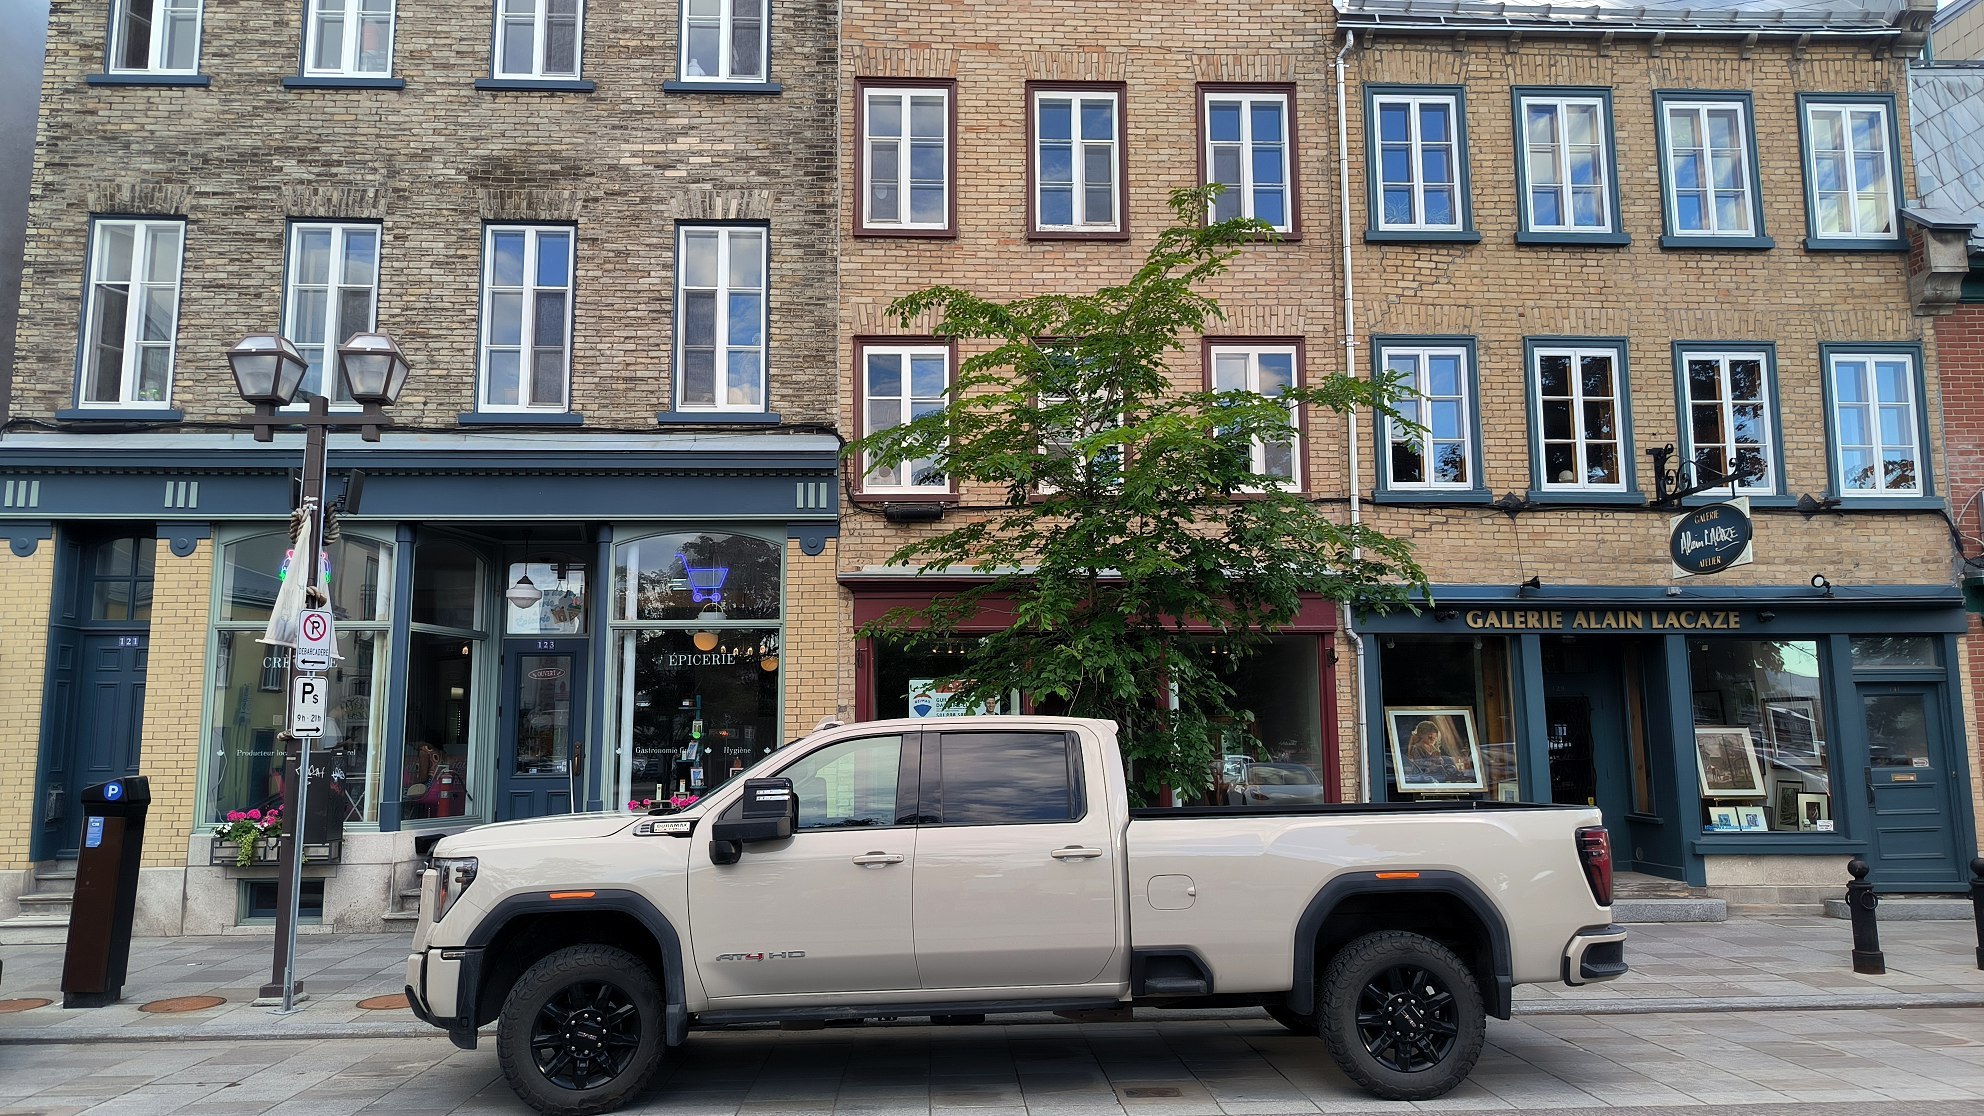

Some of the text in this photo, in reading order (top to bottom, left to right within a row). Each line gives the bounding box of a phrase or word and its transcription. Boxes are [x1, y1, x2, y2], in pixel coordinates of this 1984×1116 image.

[1695, 510, 1720, 525] GALERIE
[1681, 530, 1705, 556] Alain
[1699, 556, 1721, 568] ATELIER
[1465, 610, 1741, 629] GALERIE ALAIN LACAZE
[119, 637, 137, 645] 121
[537, 641, 555, 649] 123
[669, 652, 736, 666] ÉPICERIE
[537, 669, 556, 677] OUVERT
[236, 749, 274, 757] Producteur
[635, 746, 678, 755] Gastronomie
[723, 746, 751, 756] Hygiène
[108, 785, 119, 797] P
[716, 950, 805, 962] AT4 HD
